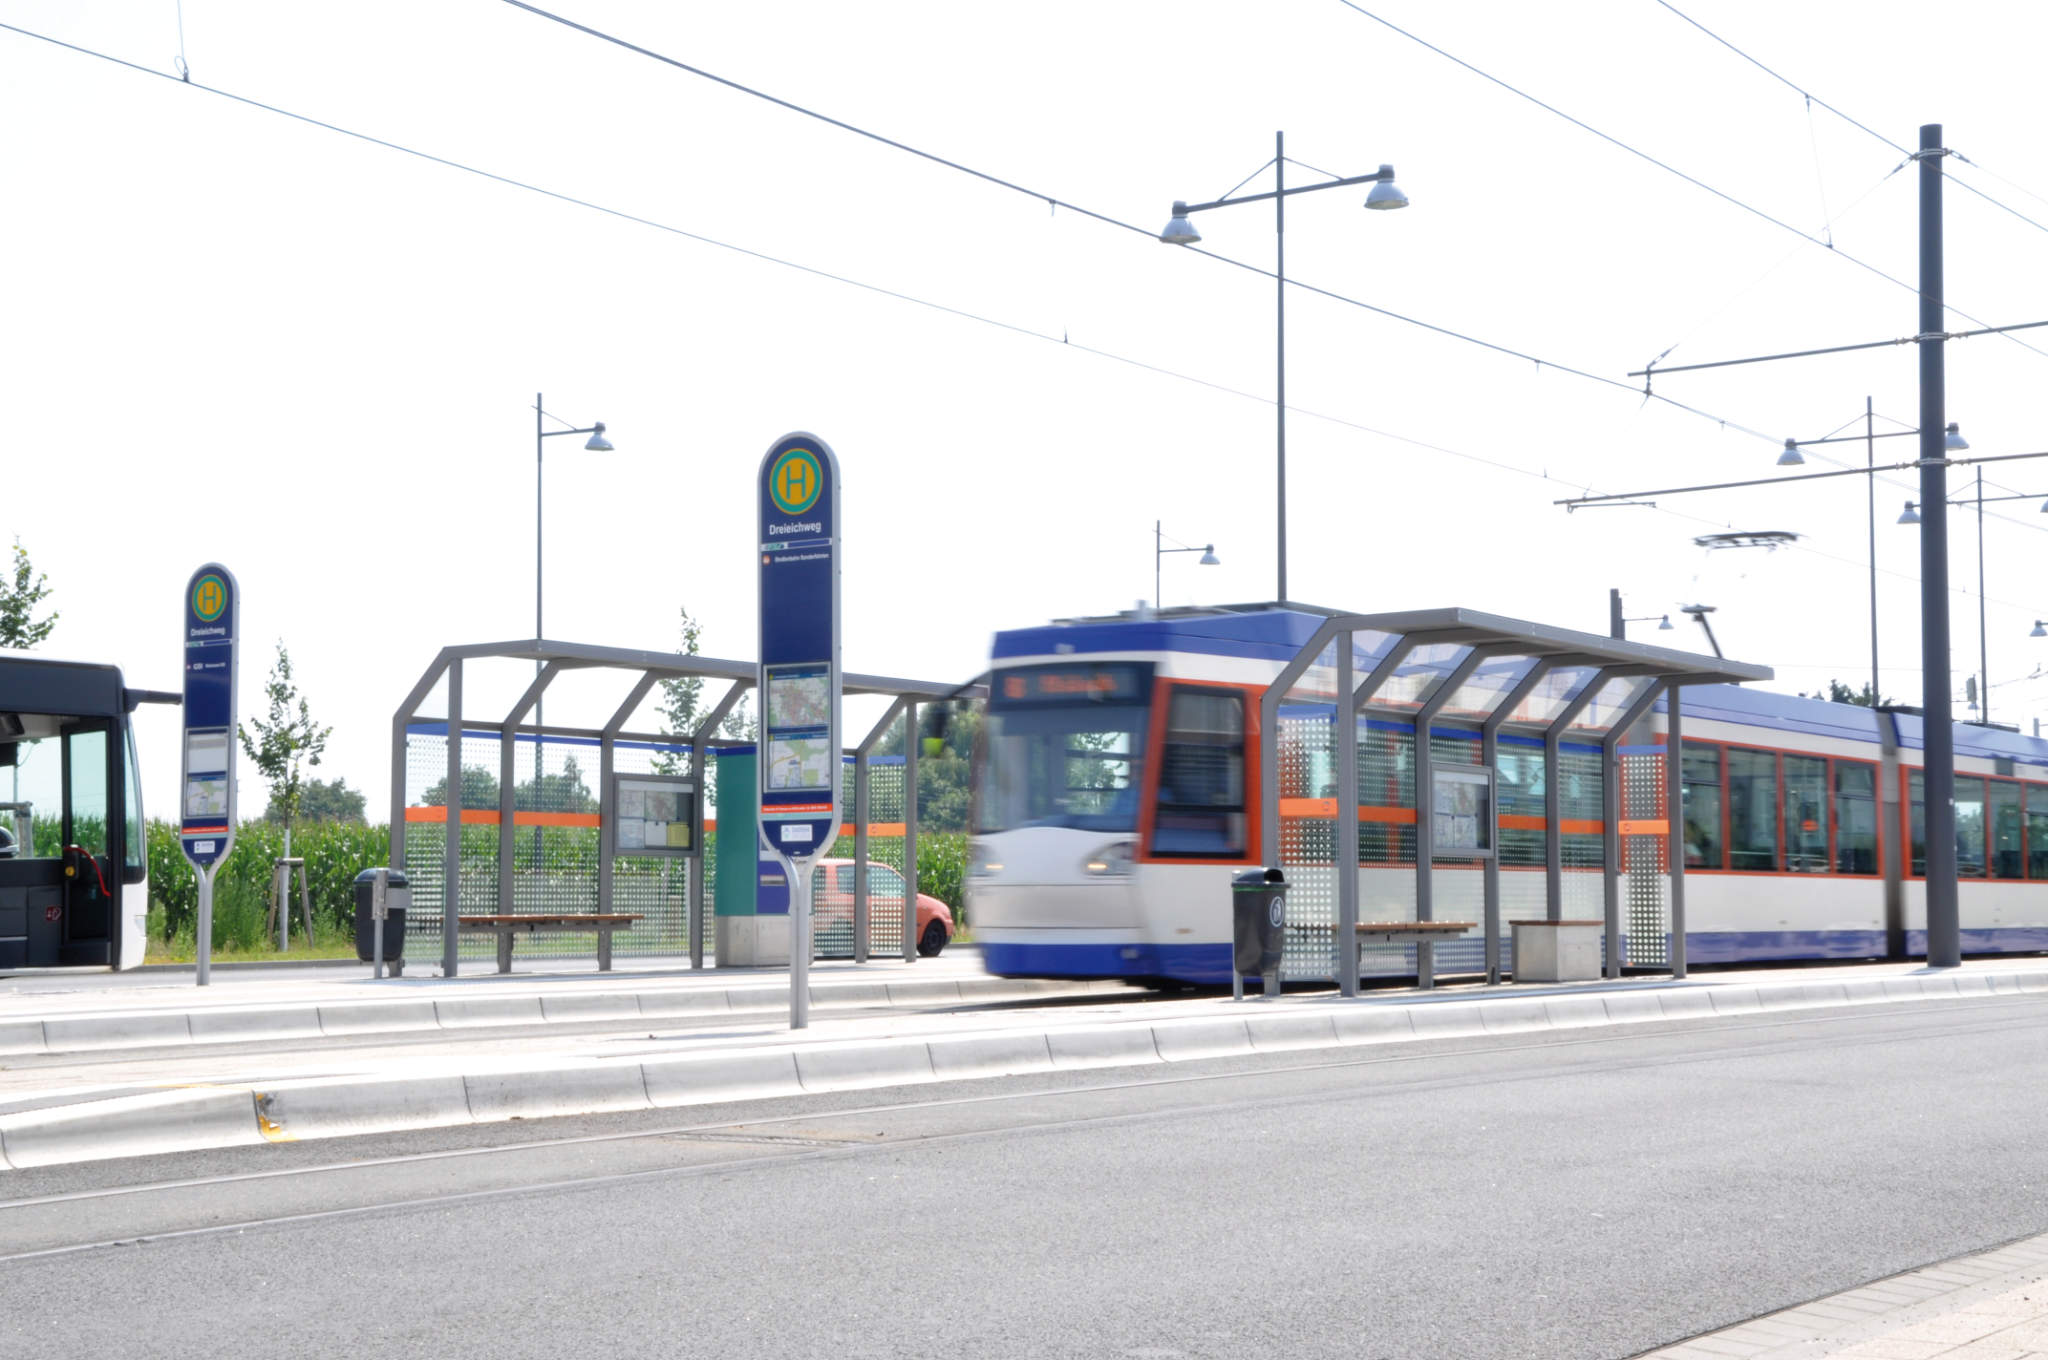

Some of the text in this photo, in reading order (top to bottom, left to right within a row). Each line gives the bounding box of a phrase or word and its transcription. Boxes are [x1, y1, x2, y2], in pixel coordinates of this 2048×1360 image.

[786, 463, 806, 499] H
[769, 521, 822, 535] Dreieichweg
[203, 584, 217, 610] H
